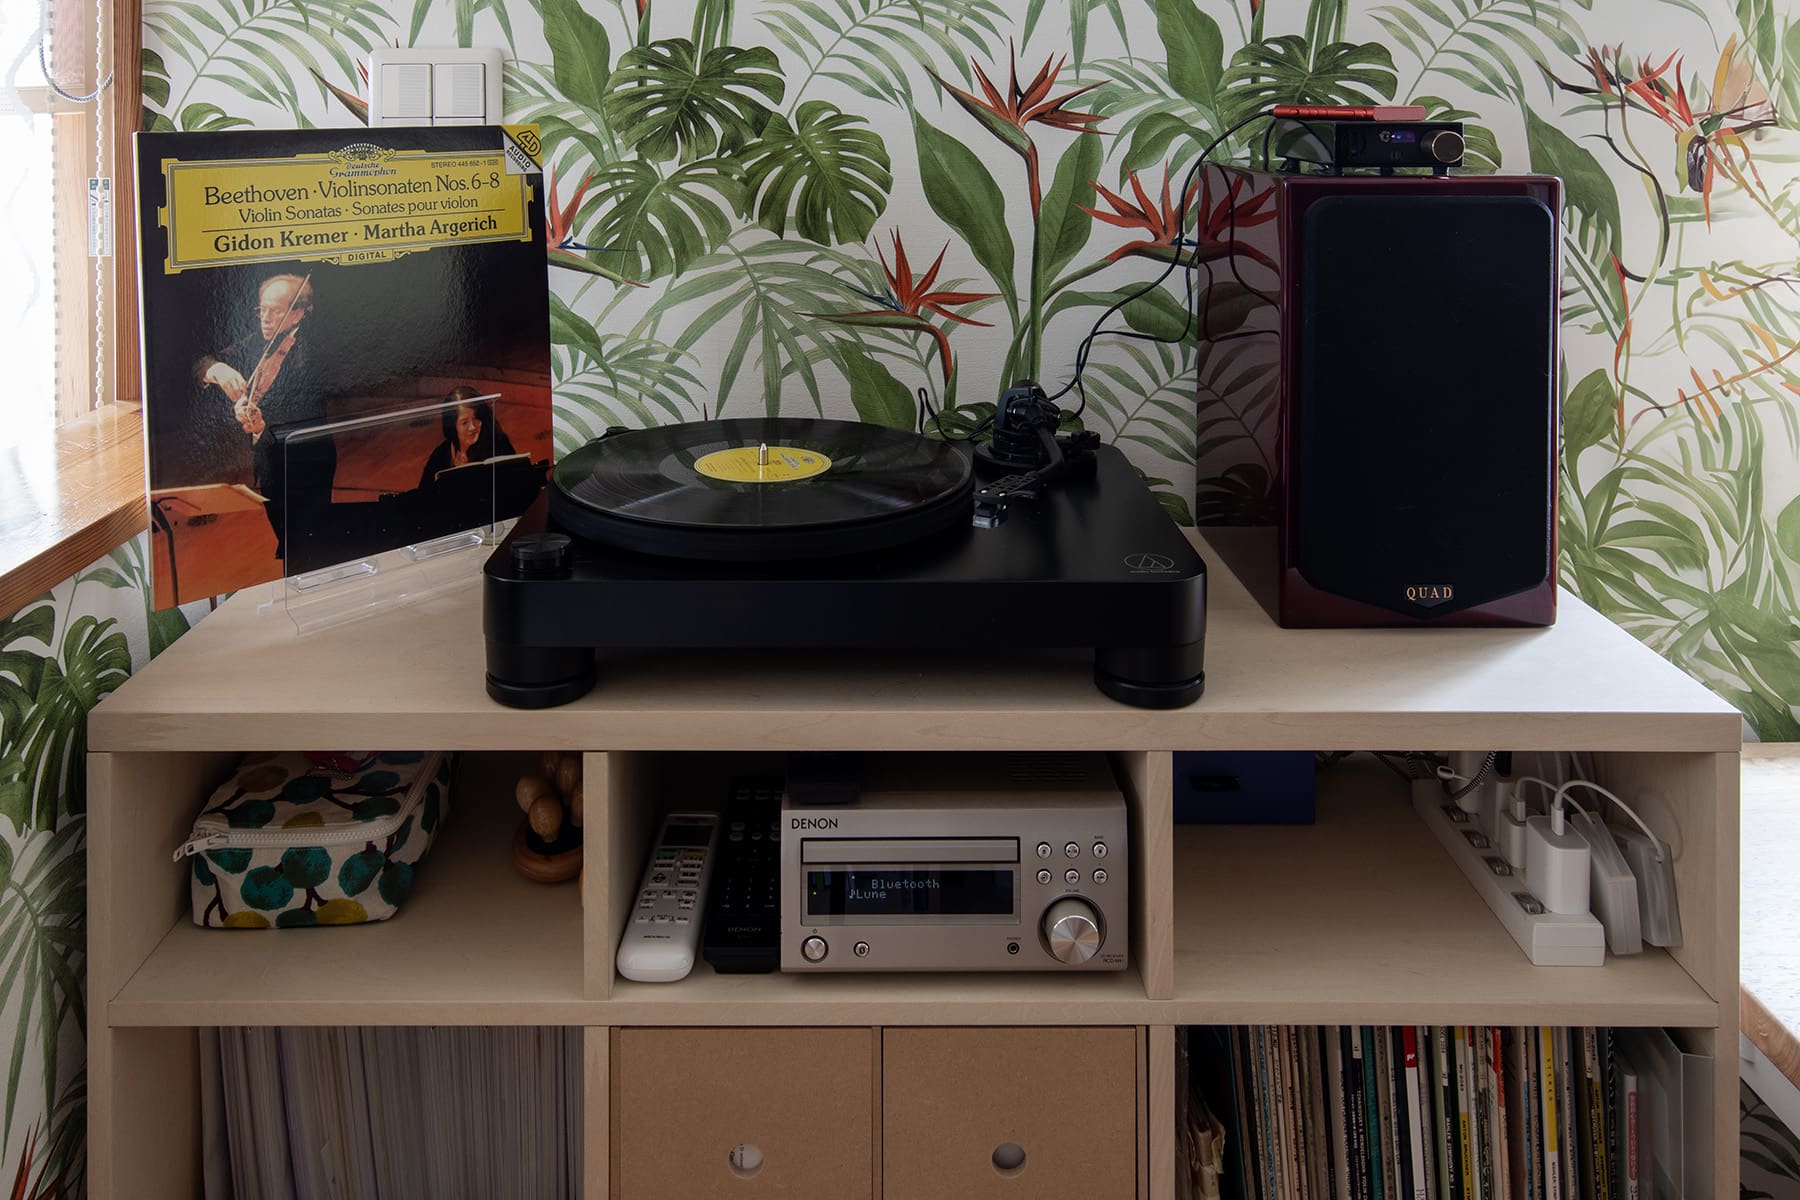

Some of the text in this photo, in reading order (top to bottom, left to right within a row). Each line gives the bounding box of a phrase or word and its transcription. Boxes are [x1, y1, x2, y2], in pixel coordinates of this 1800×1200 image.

[508, 145, 531, 169] AUDIO
[345, 161, 380, 170] Deutsche
[431, 160, 457, 168] STEREO
[329, 166, 397, 179] Grammophon
[204, 184, 309, 206] Beethoven
[318, 178, 432, 200] Violinsonaten
[238, 195, 478, 223] Violin Sonatas Sonates pour violon
[213, 215, 497, 253] Gidon Kremer Martha Argerich
[347, 251, 387, 262] DIGITAL
[1406, 586, 1453, 601] QUAD
[791, 818, 838, 830] DENON
[871, 879, 940, 889] Bluetooth
[856, 889, 887, 899] Lune
